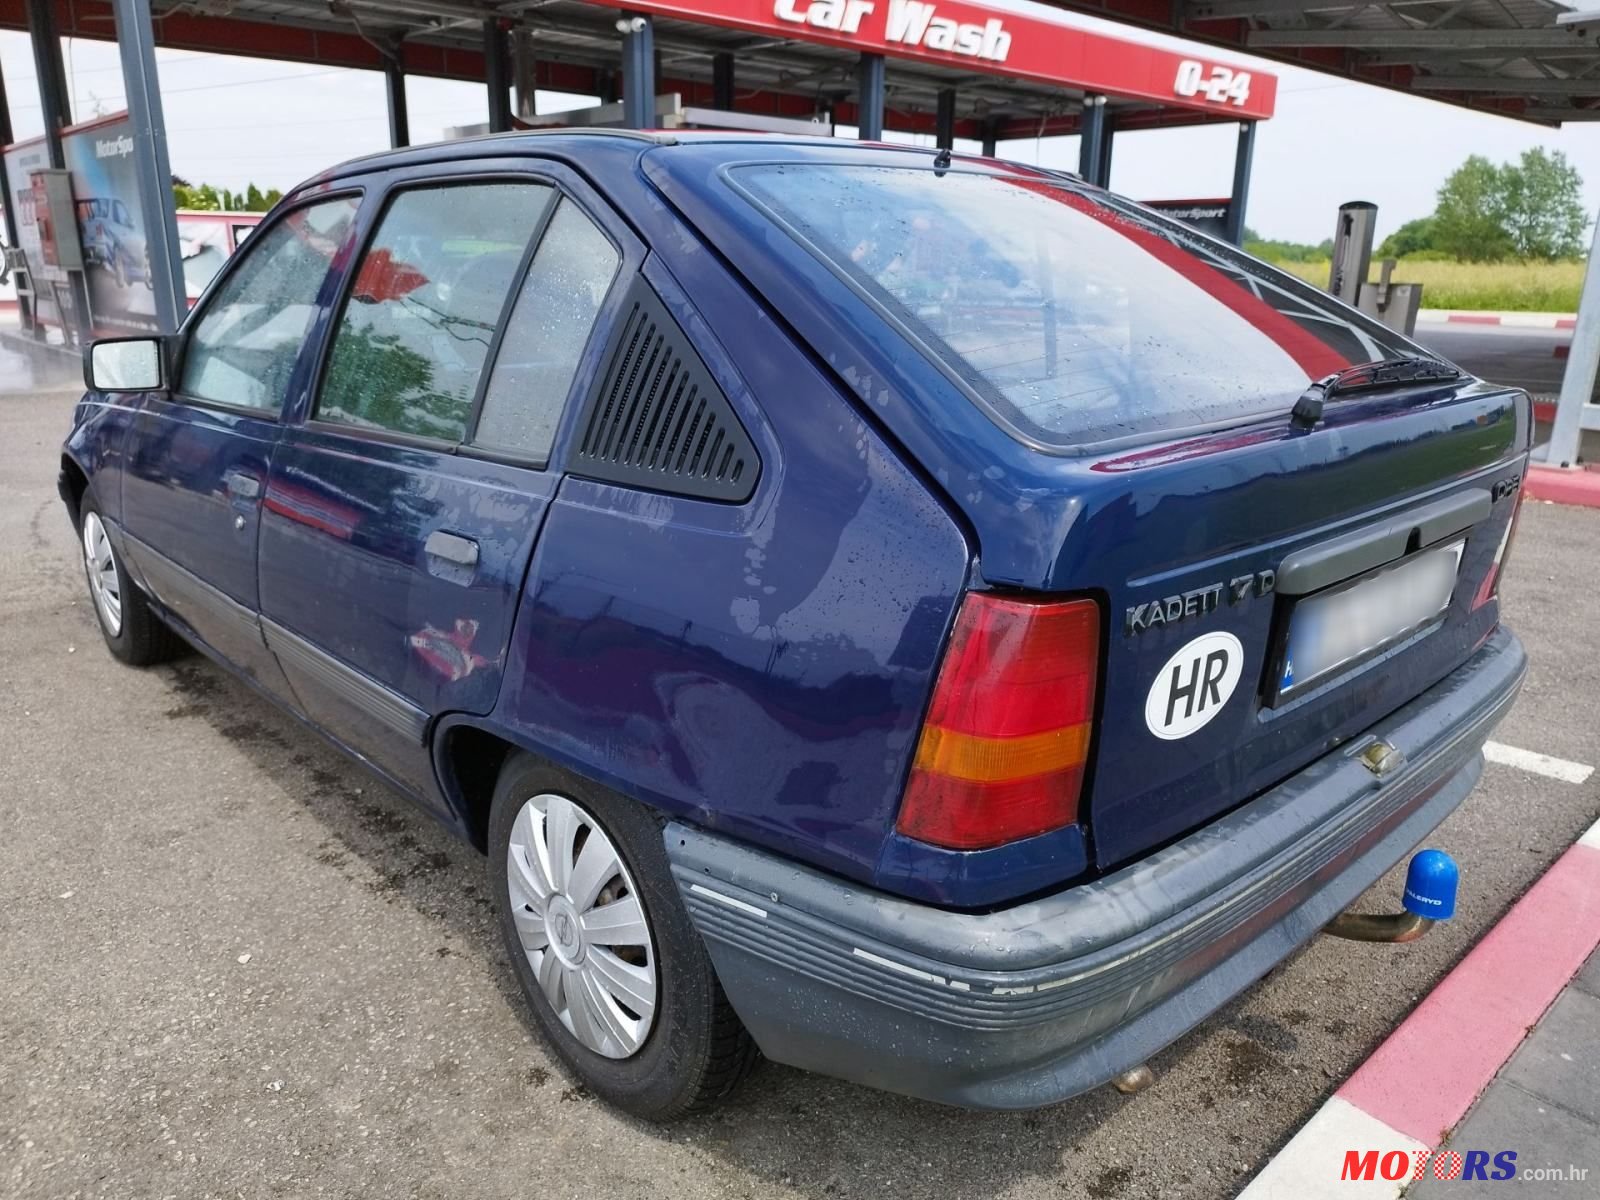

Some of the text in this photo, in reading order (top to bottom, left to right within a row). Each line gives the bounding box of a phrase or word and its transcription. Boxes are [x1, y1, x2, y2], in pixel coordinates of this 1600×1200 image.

[774, 0, 1012, 61] Car Wash
[1174, 60, 1251, 106] 0-24
[1125, 582, 1223, 633] KADETT
[1164, 648, 1229, 727] HR
